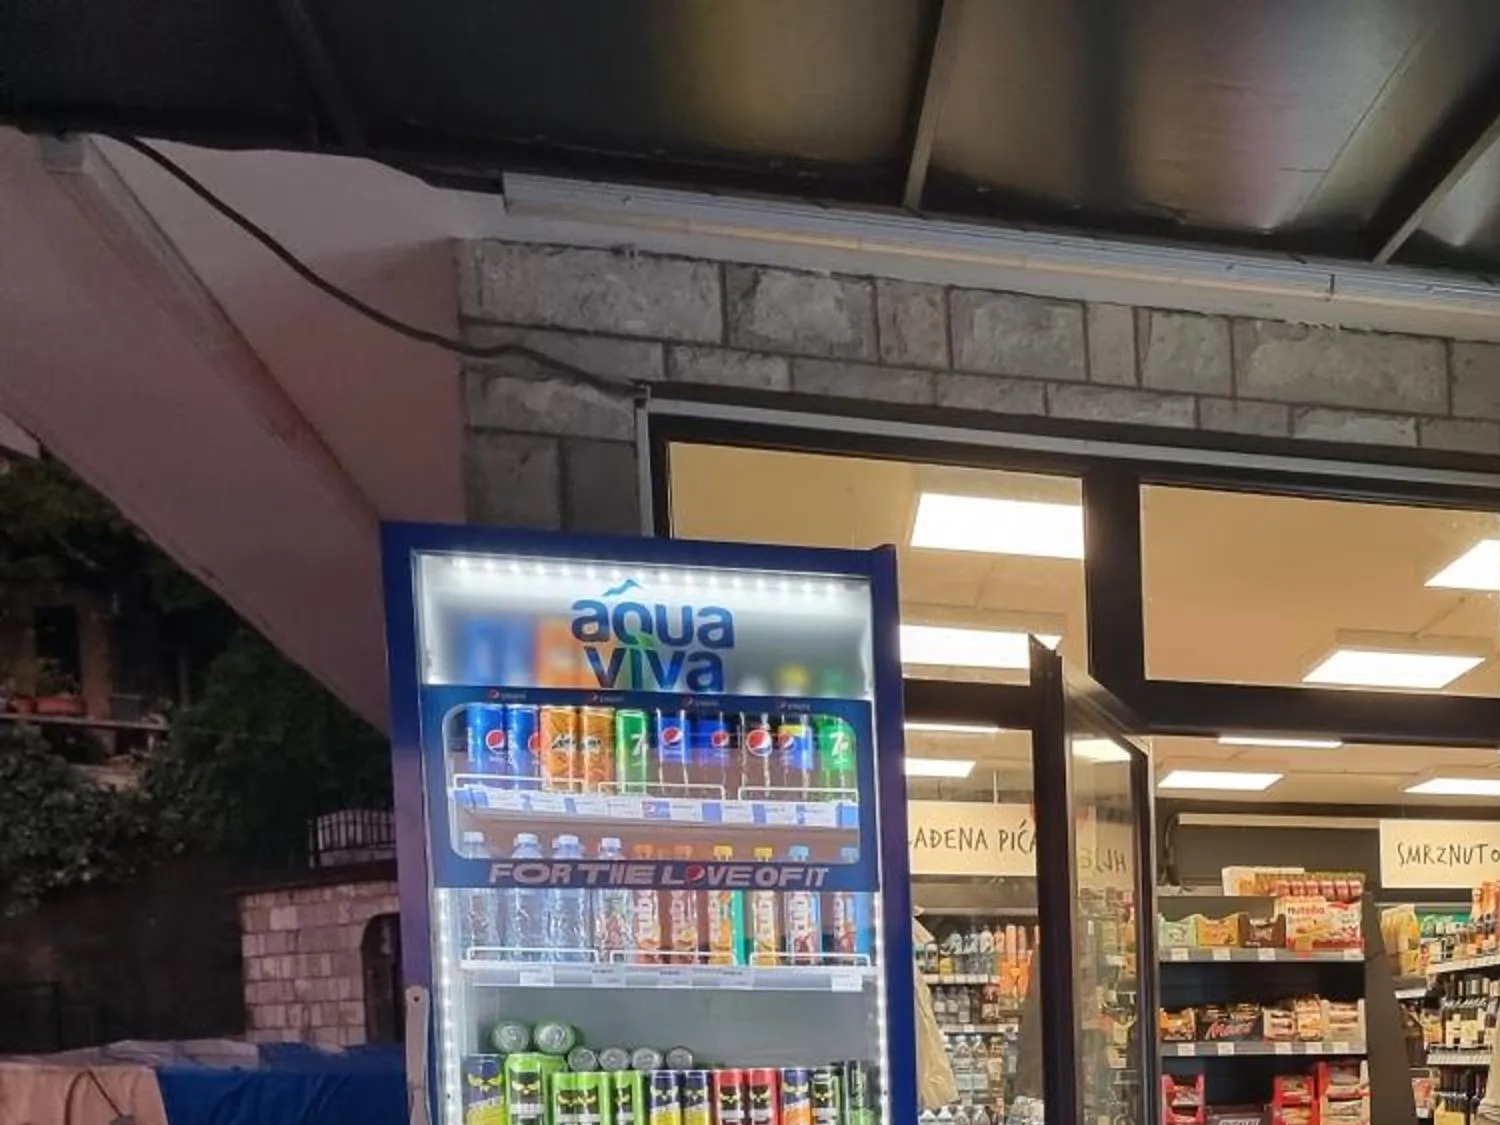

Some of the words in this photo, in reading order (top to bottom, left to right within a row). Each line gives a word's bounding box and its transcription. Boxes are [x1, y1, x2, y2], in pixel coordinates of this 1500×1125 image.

[571, 597, 735, 650] aqua
[584, 646, 725, 693] viva
[912, 827, 988, 851] AĐENA
[489, 863, 572, 886] FOR
[576, 864, 652, 886] THE
[757, 866, 806, 888] OF
[805, 867, 829, 888] IT
